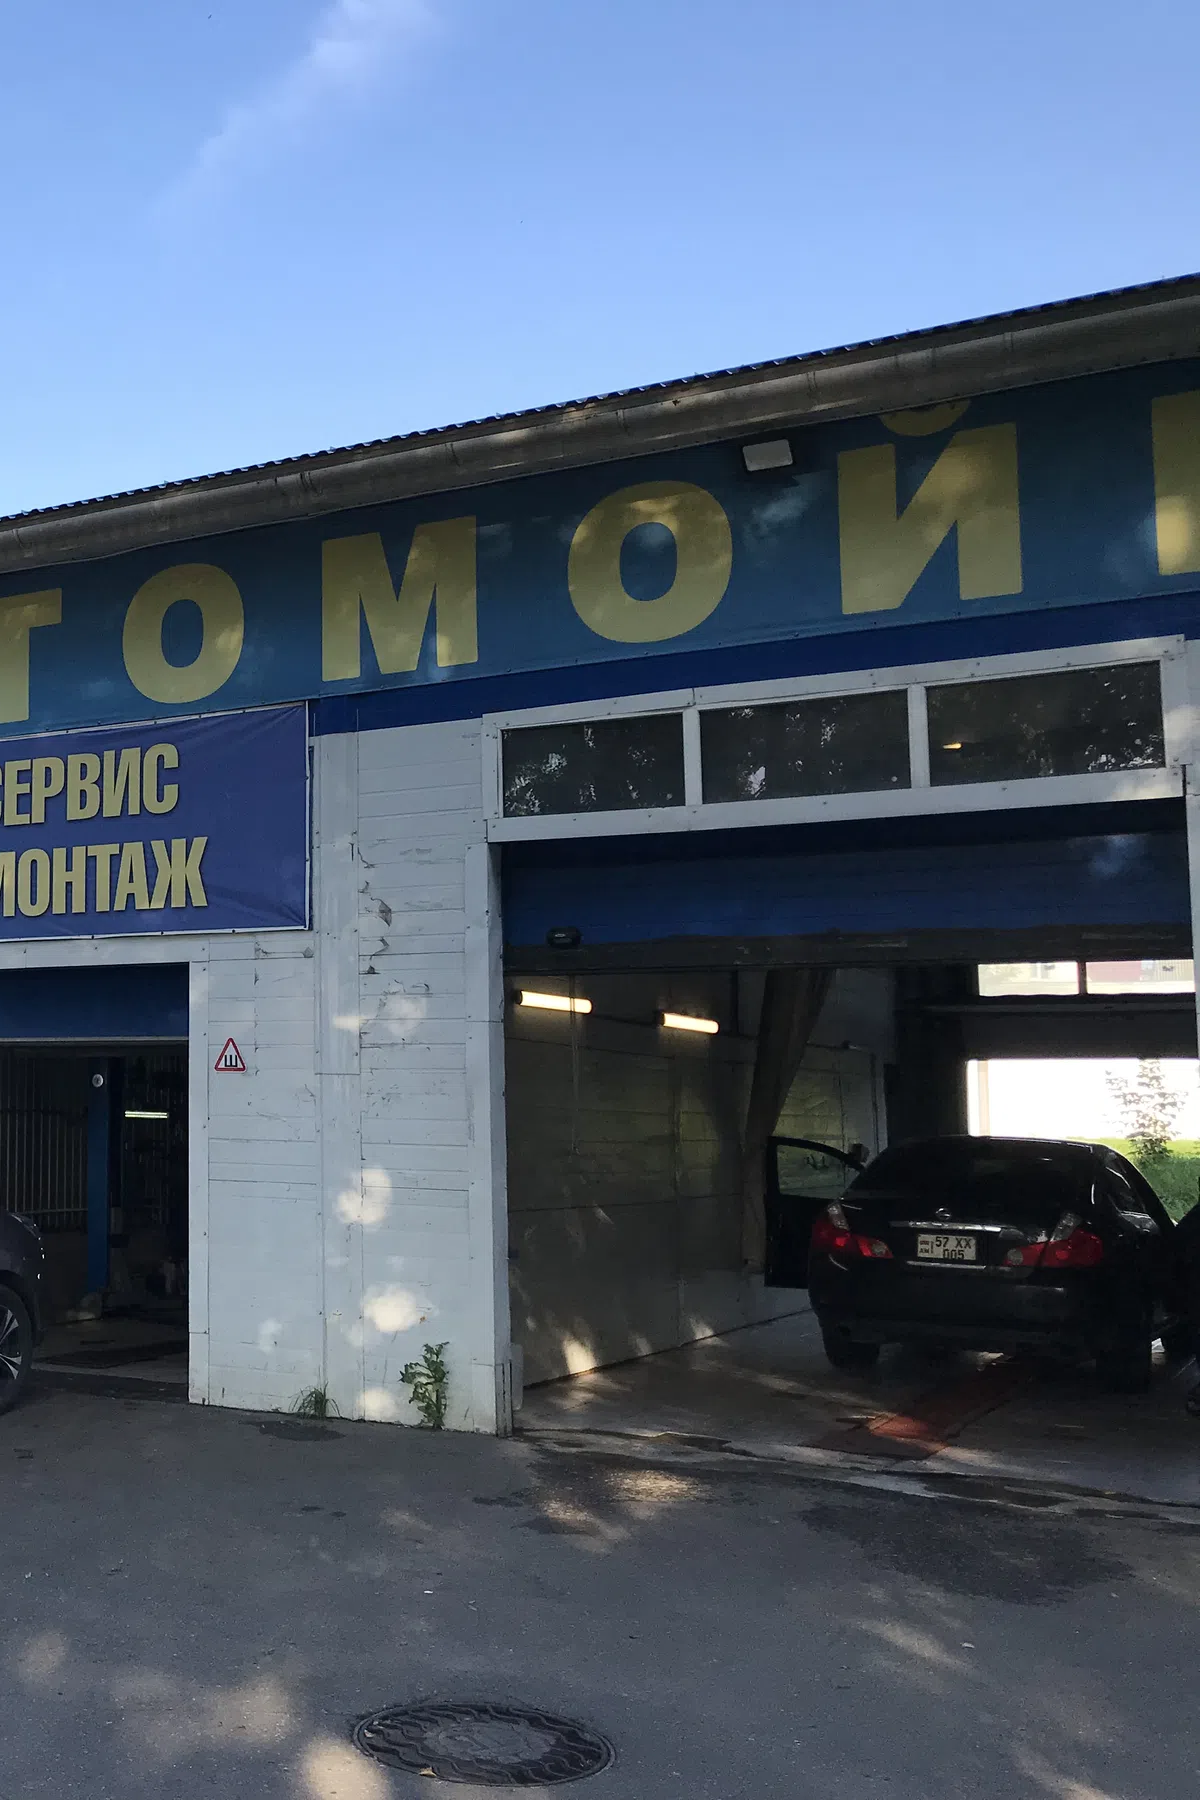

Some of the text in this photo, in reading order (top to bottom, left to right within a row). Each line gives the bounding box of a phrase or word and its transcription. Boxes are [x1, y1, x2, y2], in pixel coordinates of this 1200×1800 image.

[224, 1054, 238, 1068] Ш
[936, 1236, 972, 1248] 57 XX
